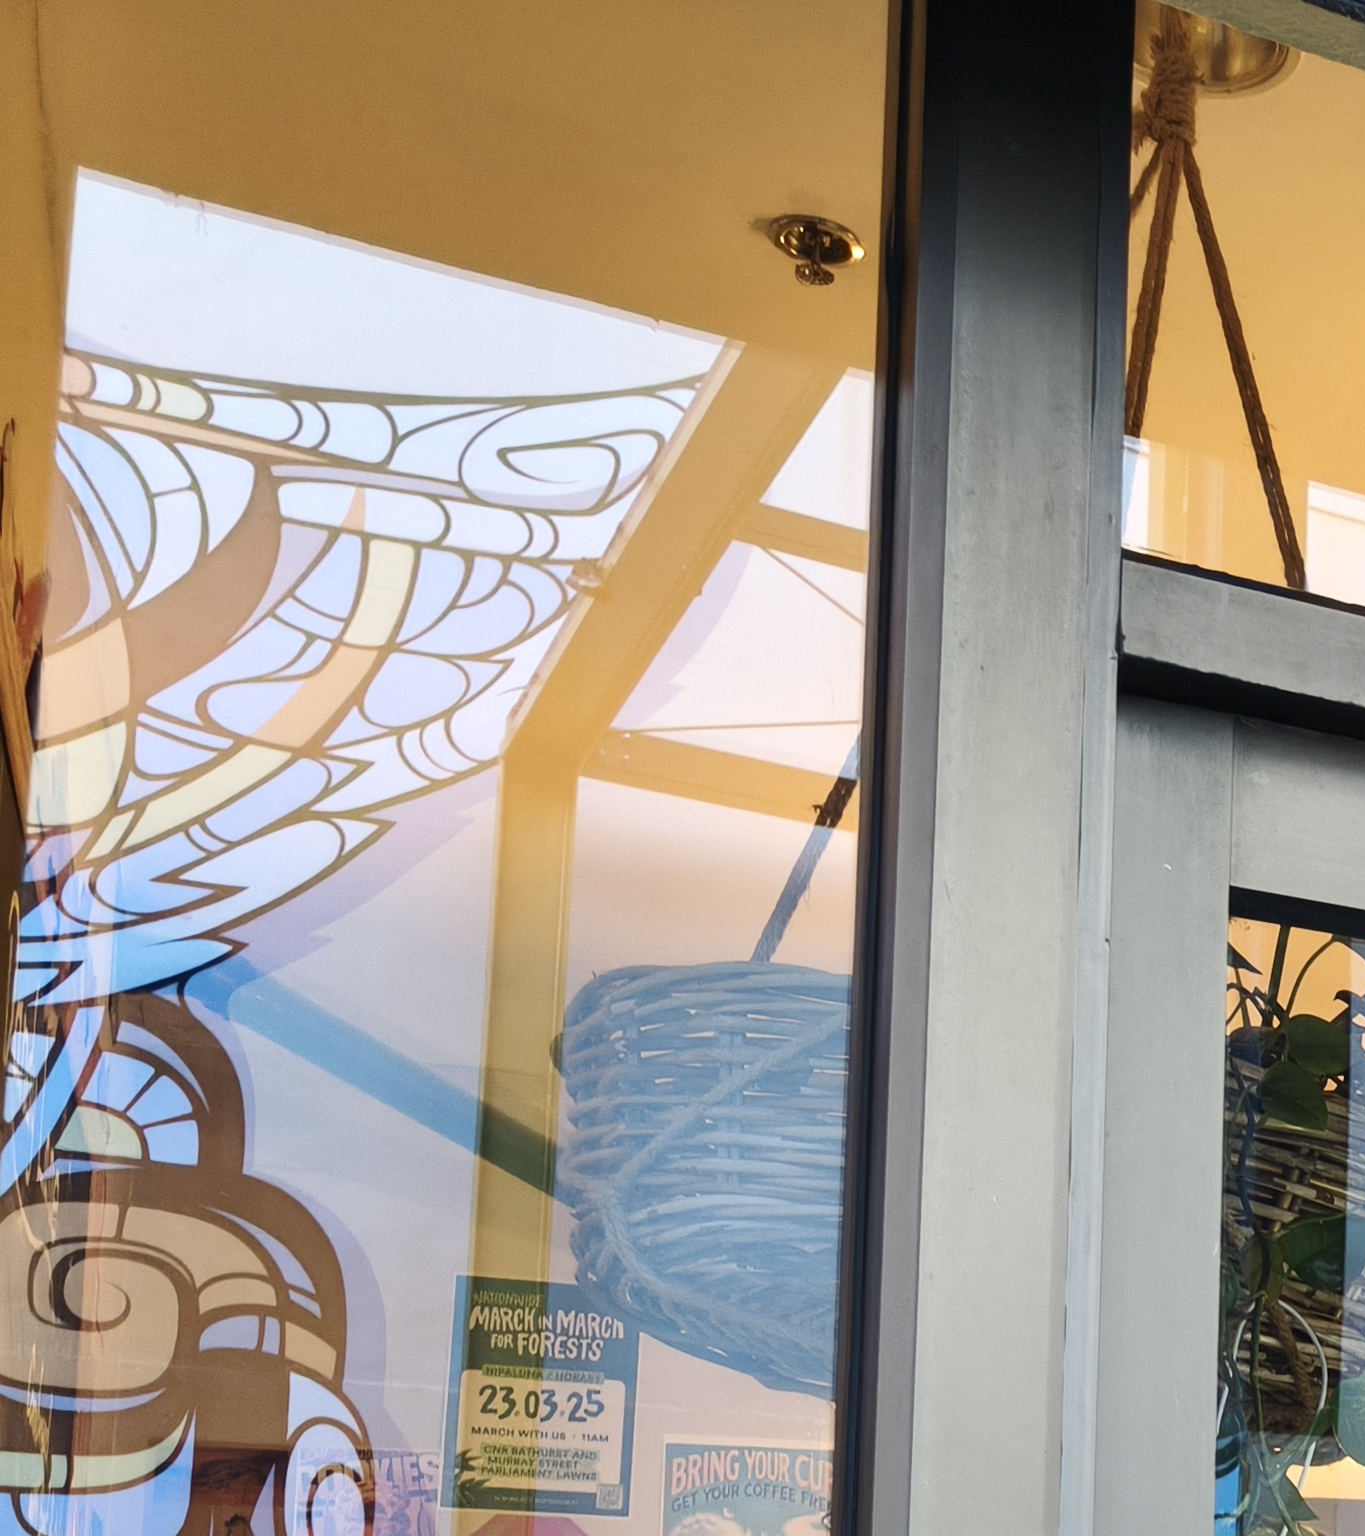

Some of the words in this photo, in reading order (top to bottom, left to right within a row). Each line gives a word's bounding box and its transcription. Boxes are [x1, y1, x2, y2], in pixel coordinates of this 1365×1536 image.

[469, 1305, 534, 1332] MARCH
[538, 1314, 552, 1330] IN
[556, 1309, 624, 1339] MARCH
[490, 1333, 514, 1349] FOR
[517, 1331, 603, 1361] FORESTS
[478, 1384, 605, 1423] 23.03.25
[471, 1426, 515, 1438] MARCH
[519, 1429, 548, 1440] WITH
[582, 1433, 609, 1443] 11AM
[671, 1449, 741, 1497] BRING
[744, 1450, 790, 1484] YOUR
[671, 1493, 698, 1513] GET
[704, 1483, 740, 1503] YOUR
[744, 1482, 797, 1504] COFFEE
